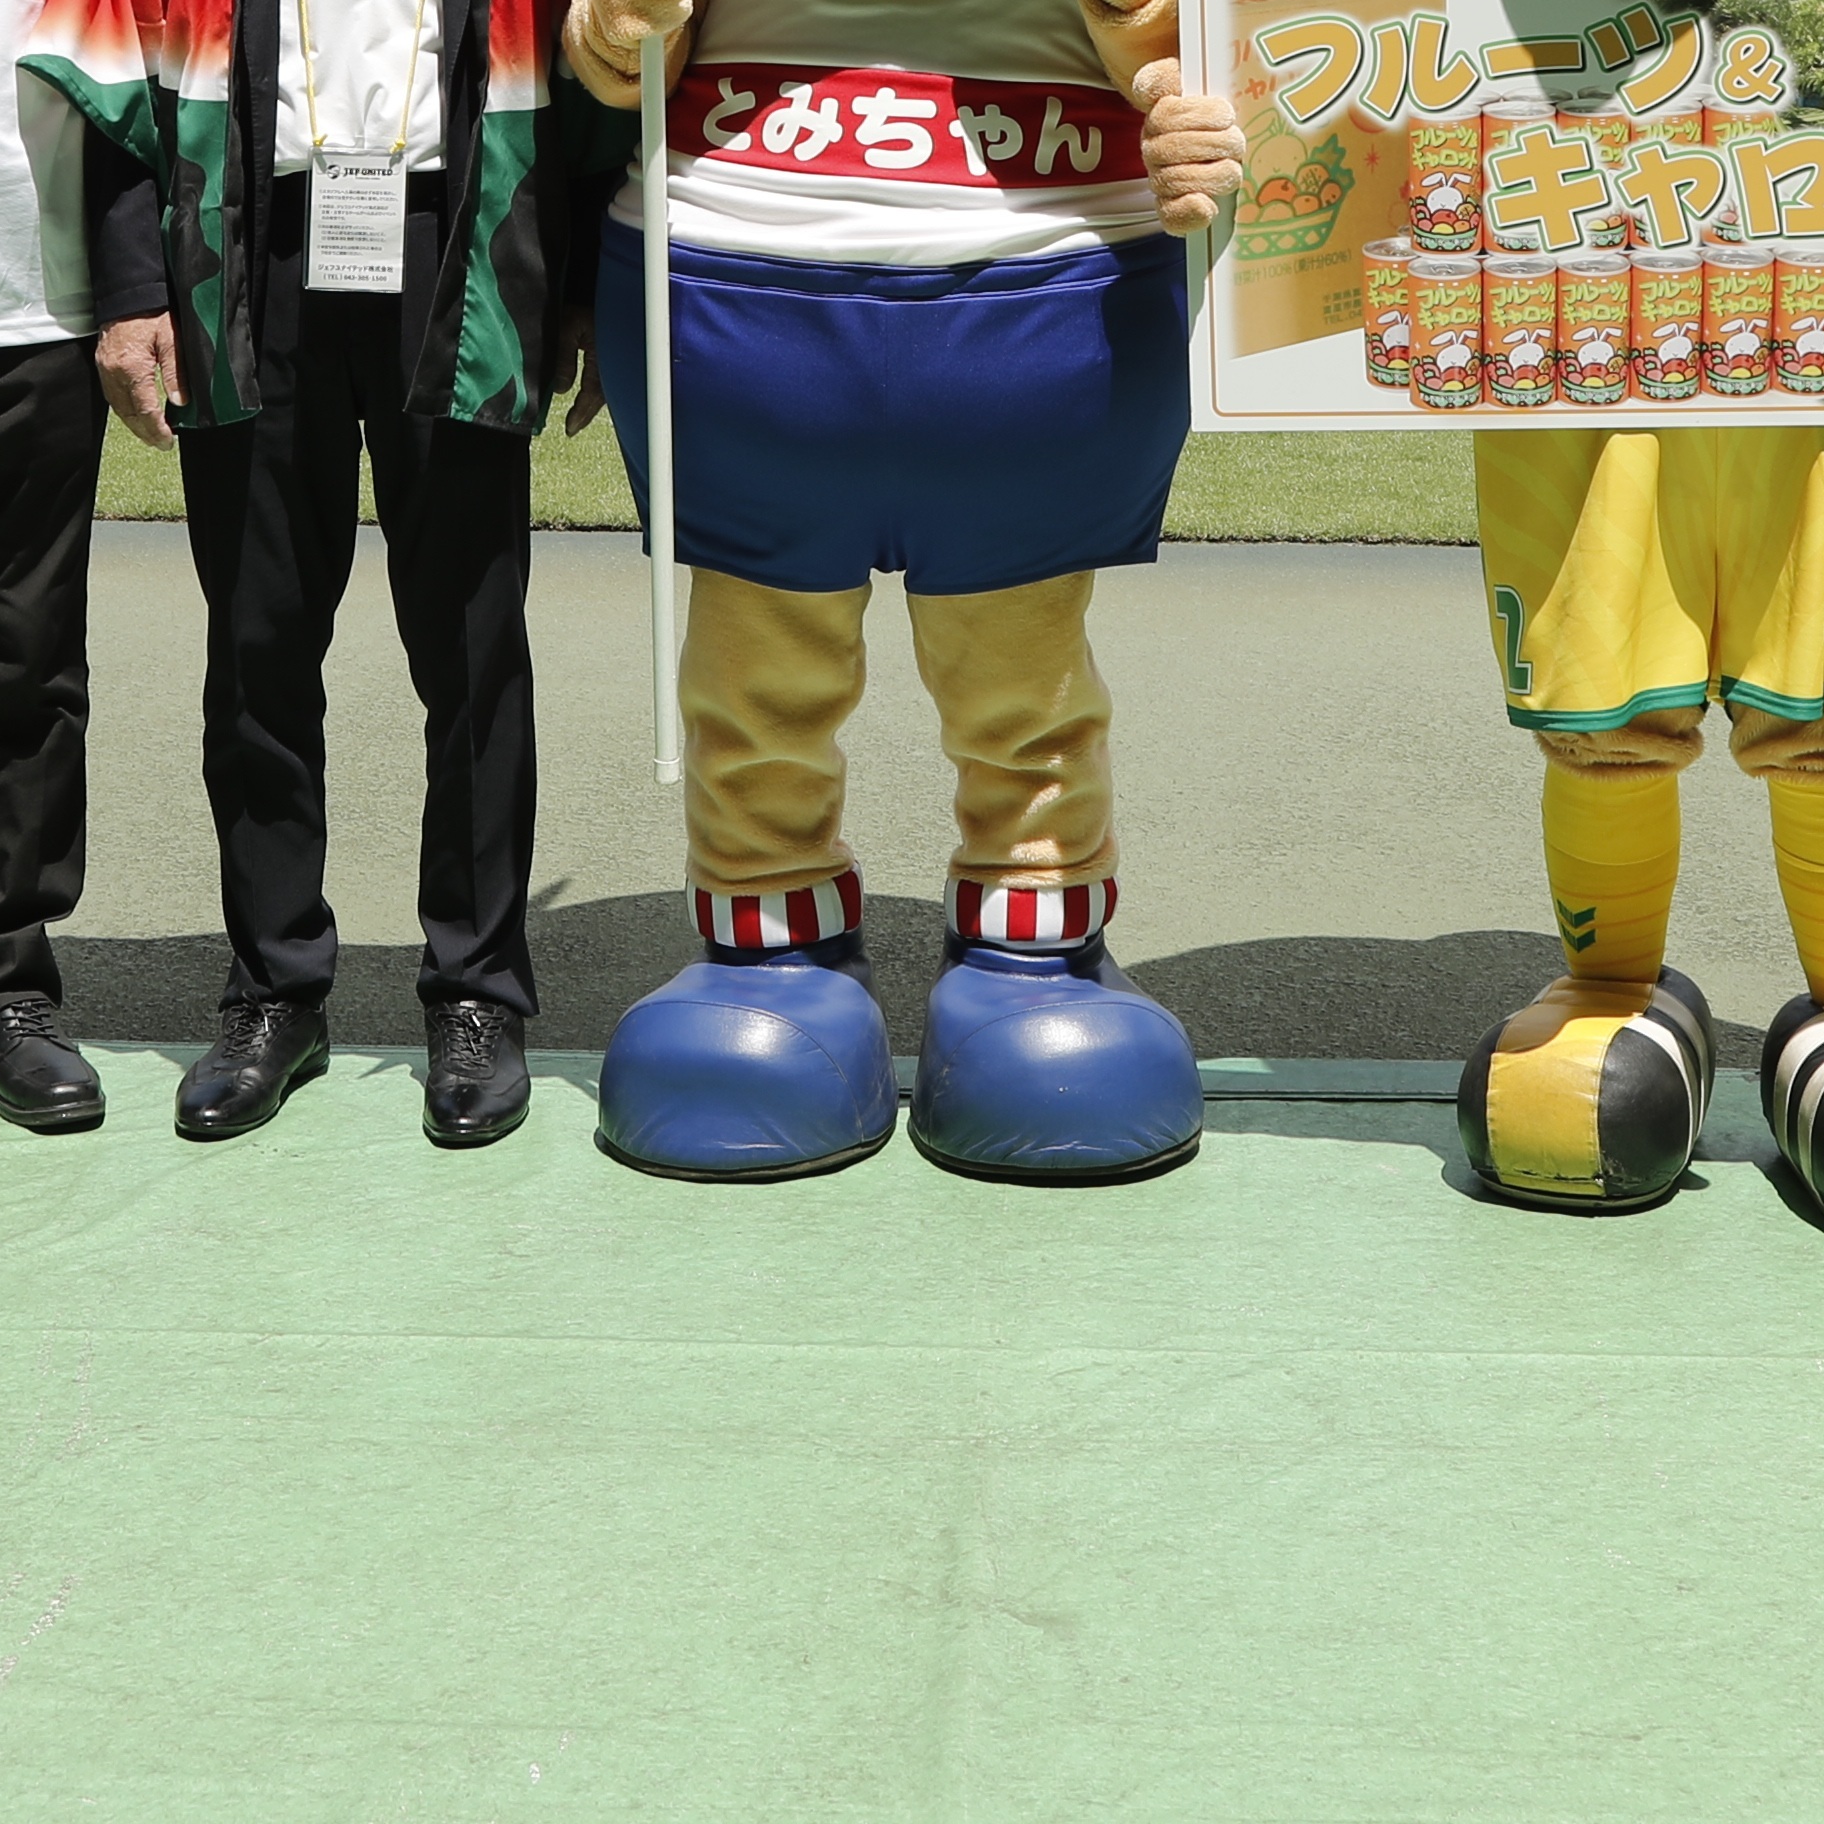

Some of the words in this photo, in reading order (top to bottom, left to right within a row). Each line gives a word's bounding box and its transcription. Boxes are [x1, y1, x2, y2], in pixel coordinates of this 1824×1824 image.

[1256, 2, 1702, 124] フルーツ
[1716, 27, 1787, 106] &
[701, 76, 1103, 177] とみちゃん
[1494, 586, 1533, 694] 2
